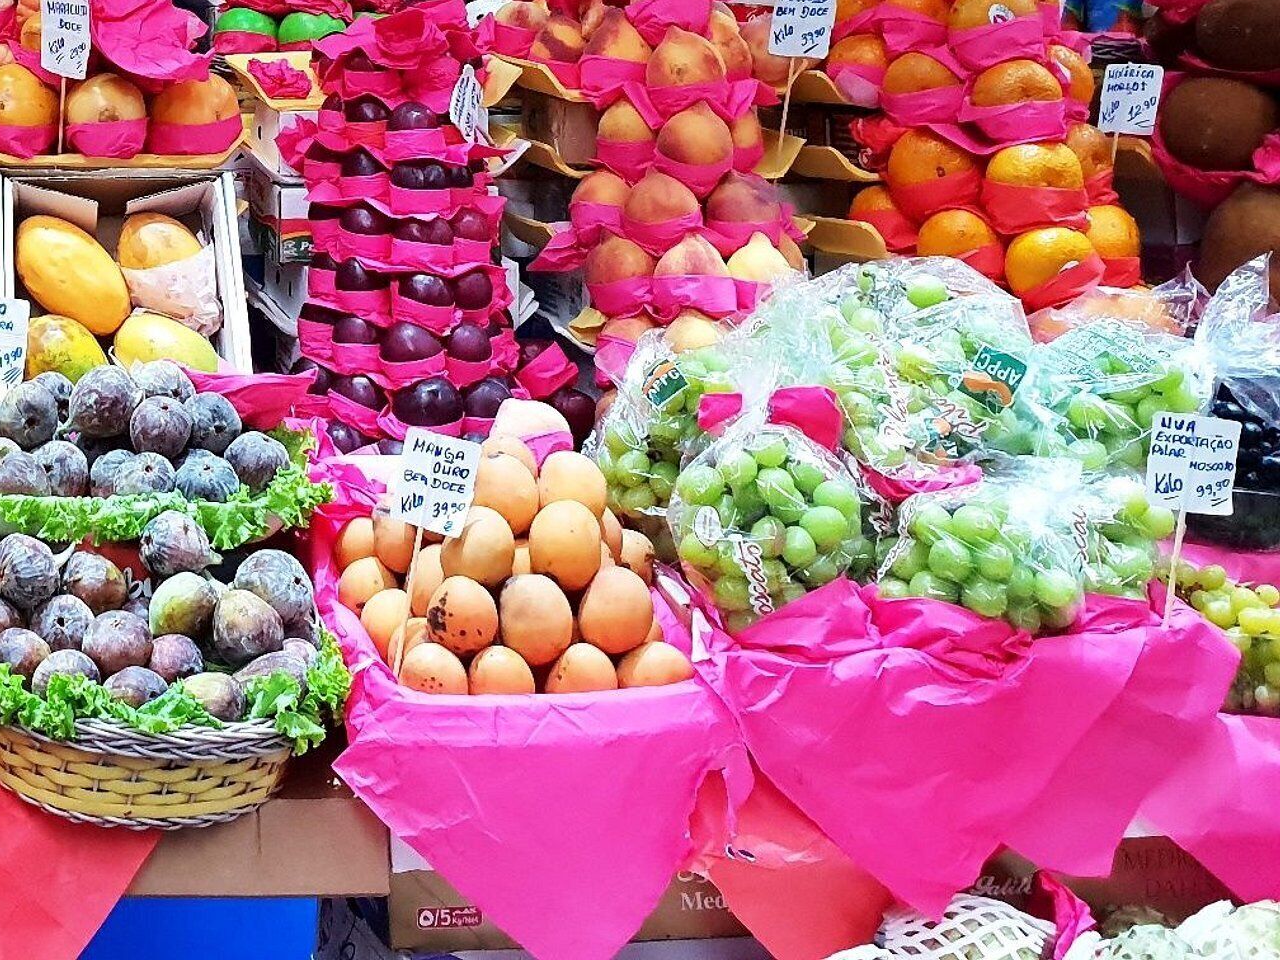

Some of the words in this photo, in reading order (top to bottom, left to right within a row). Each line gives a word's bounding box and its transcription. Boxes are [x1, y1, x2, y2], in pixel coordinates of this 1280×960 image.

[776, 6, 796, 16] BEM
[800, 6, 829, 18] DOCE
[413, 438, 465, 464] MANGA
[433, 462, 469, 479] OURO
[431, 478, 466, 493] DOCE
